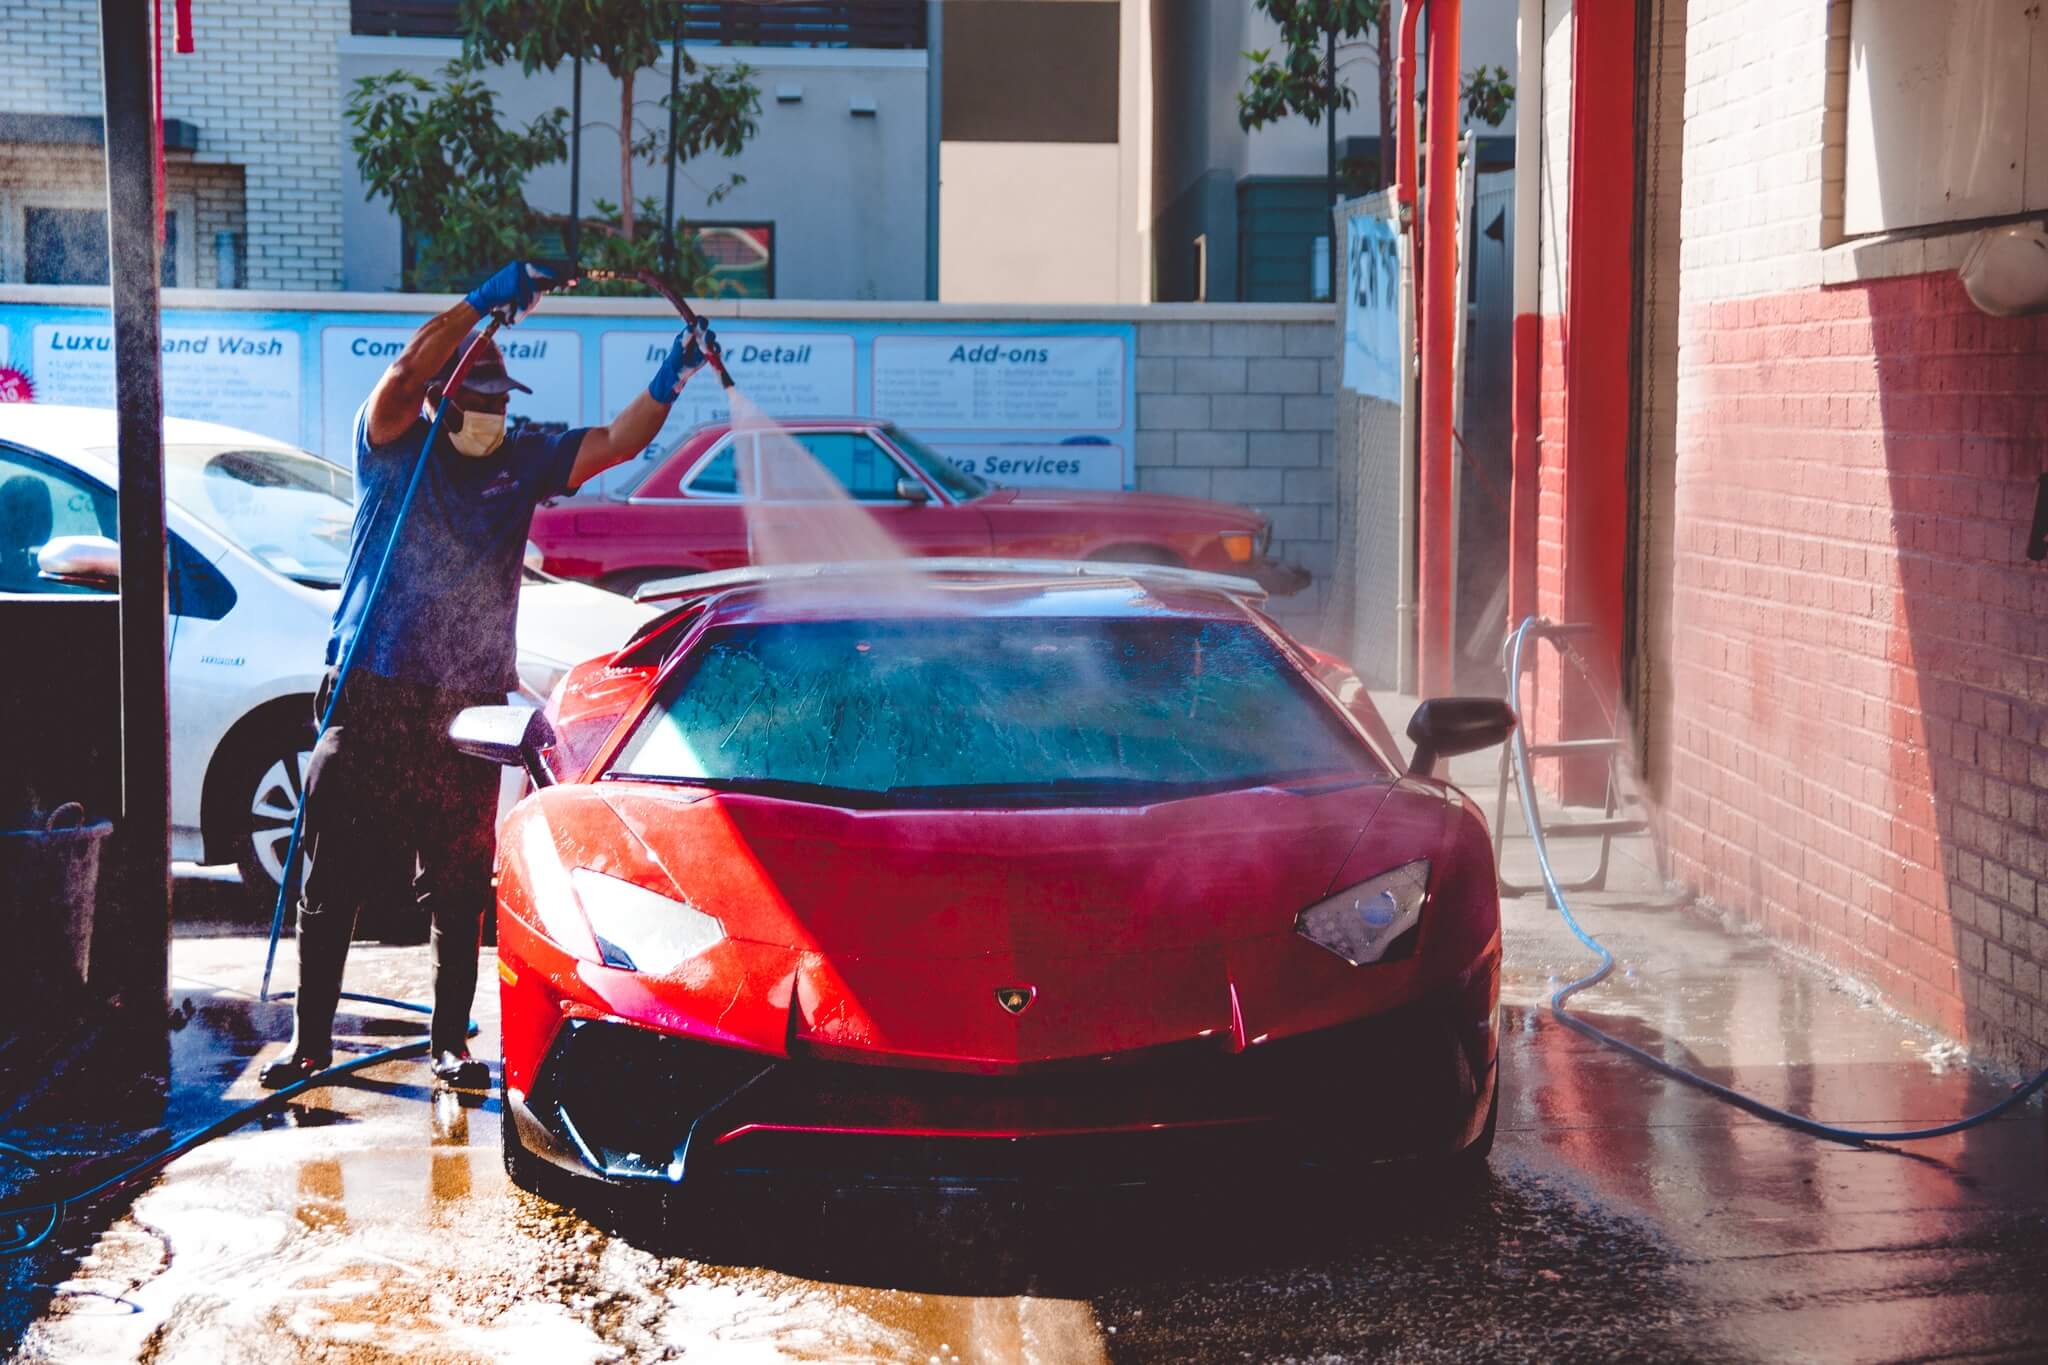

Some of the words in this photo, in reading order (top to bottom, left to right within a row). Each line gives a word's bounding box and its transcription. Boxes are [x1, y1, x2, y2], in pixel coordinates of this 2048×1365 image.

[51, 331, 113, 351] Luxu
[162, 336, 208, 355] and
[217, 335, 284, 357] Wash
[741, 344, 812, 364] Detail
[949, 344, 1049, 365] Add-ons
[984, 454, 1081, 475] Services
